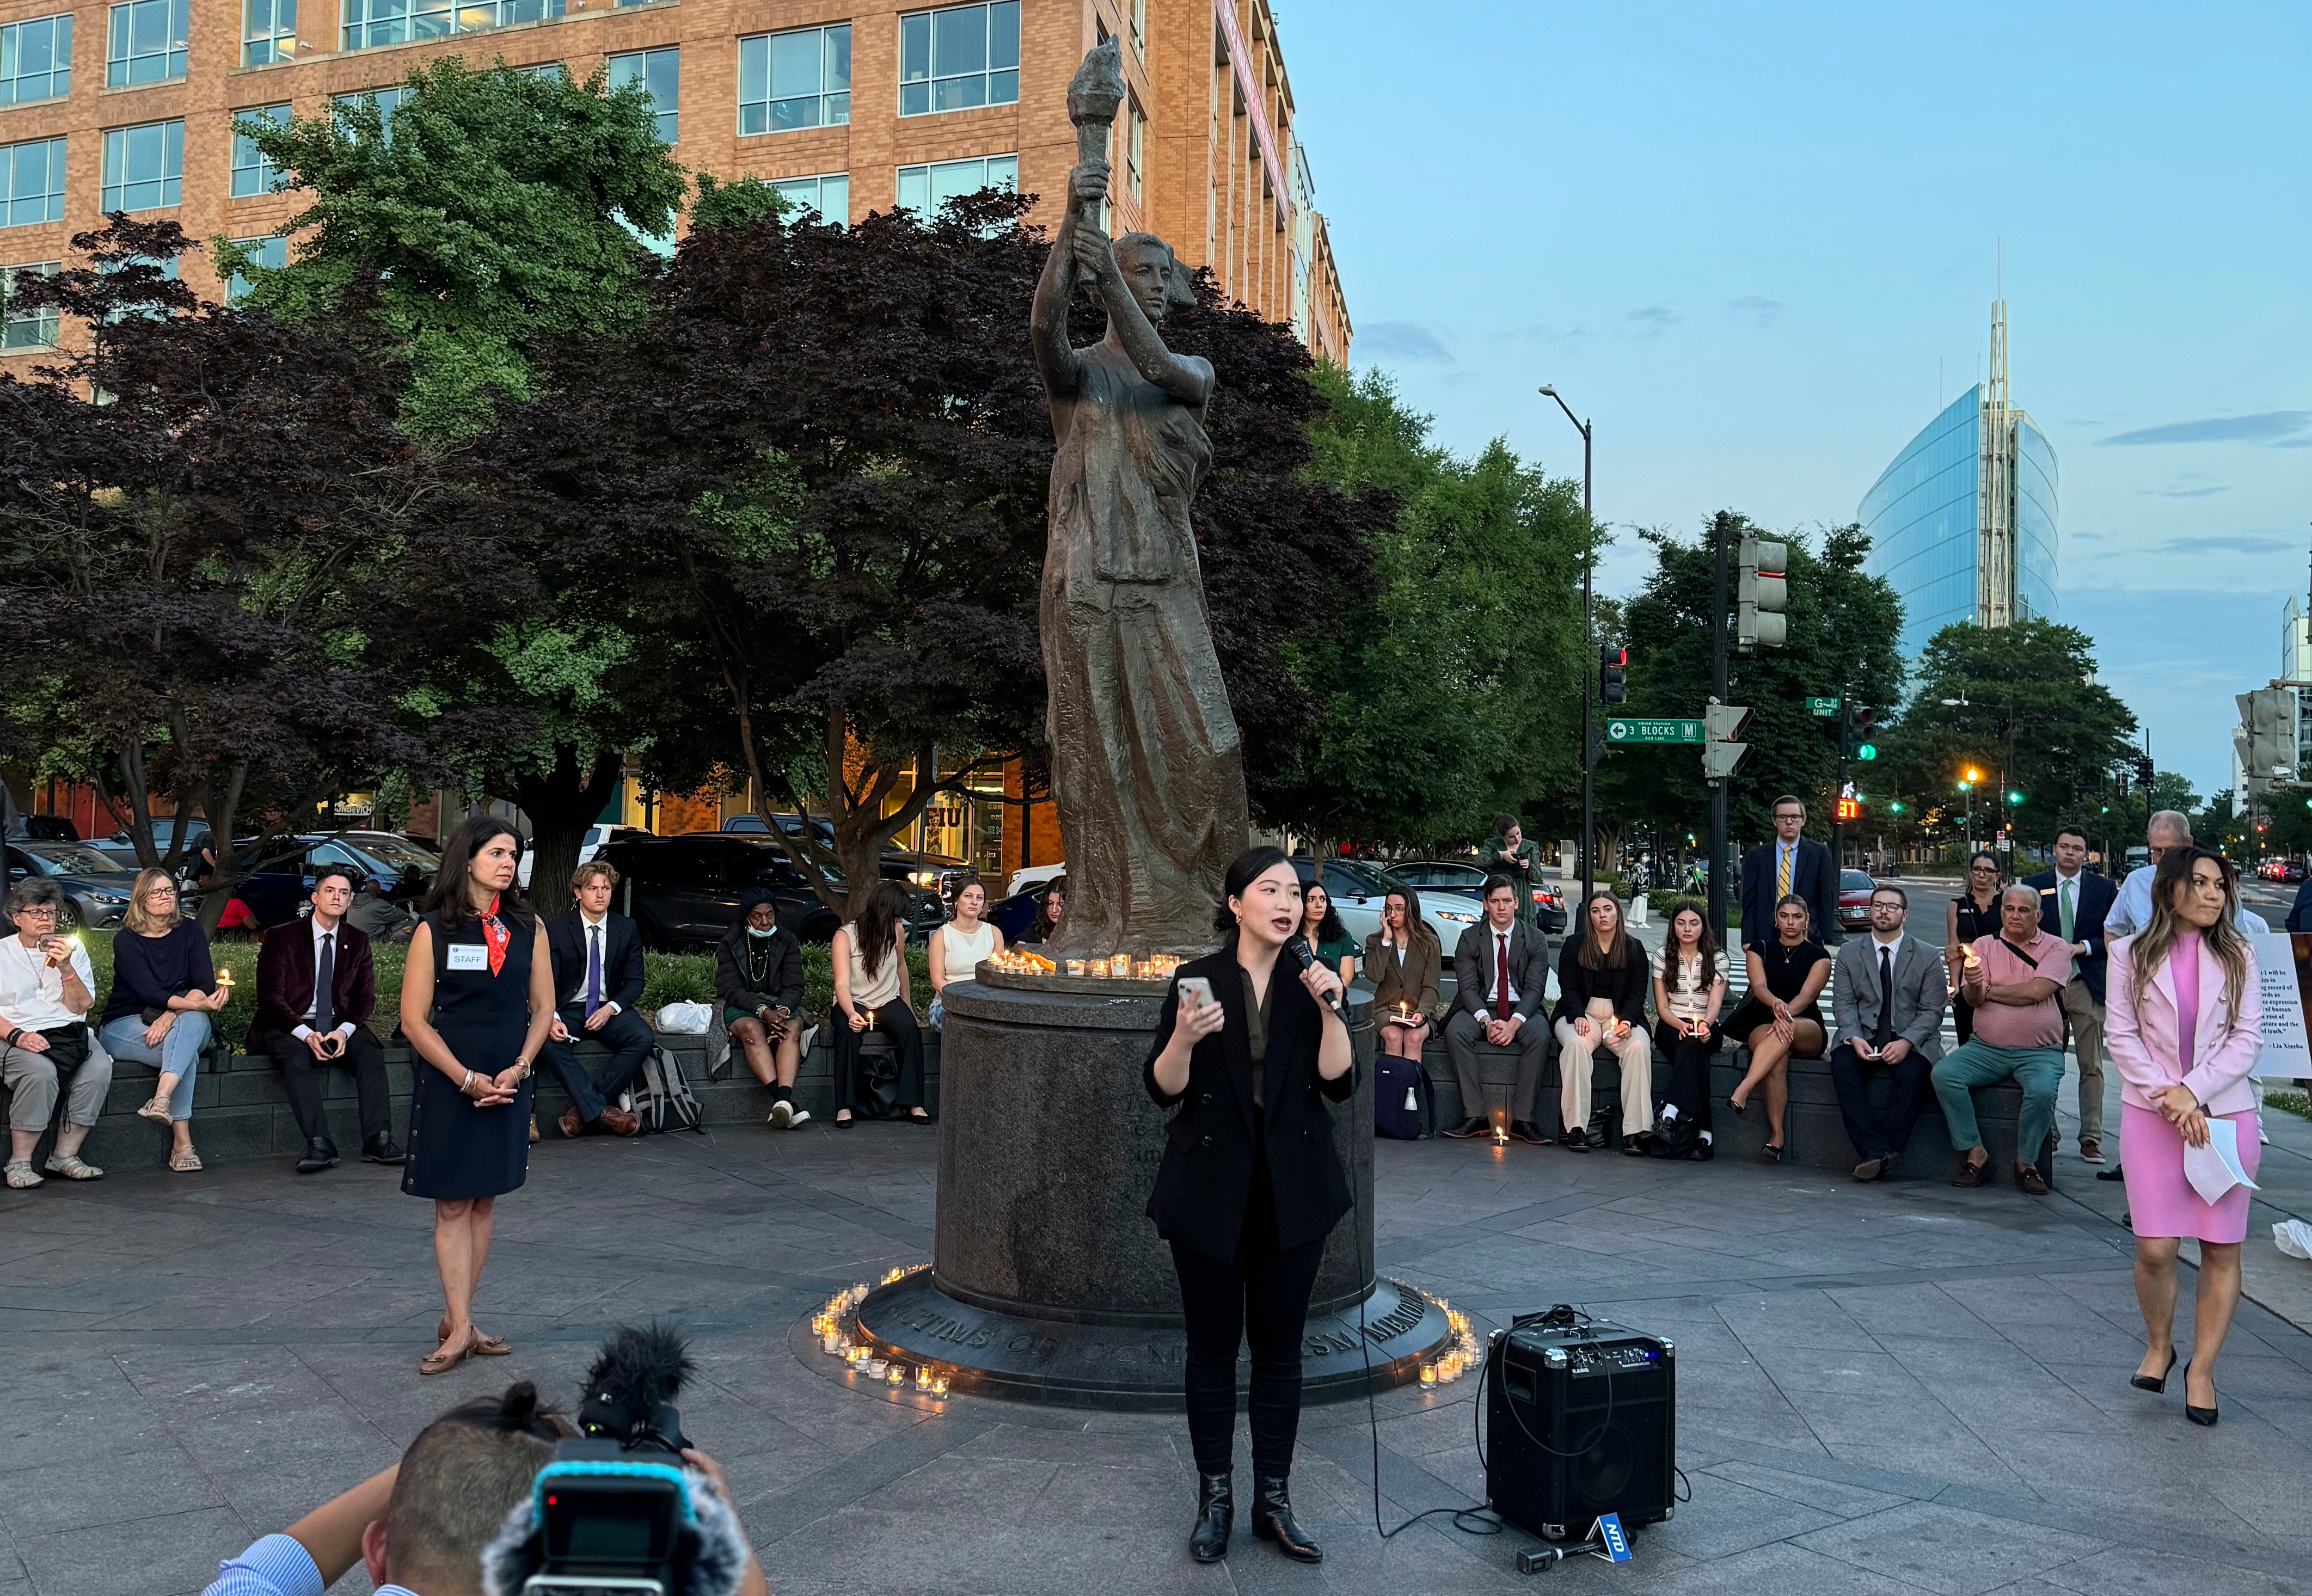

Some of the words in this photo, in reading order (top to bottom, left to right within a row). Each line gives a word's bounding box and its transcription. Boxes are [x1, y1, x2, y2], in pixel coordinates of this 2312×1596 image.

[1814, 698, 1823, 708] G
[1813, 708, 1833, 716] UNIT
[1629, 726, 1634, 735] 3
[1641, 726, 1675, 735] BLOCKS
[1684, 725, 1694, 736] M
[1839, 801, 1855, 818] 37
[1083, 1330, 1362, 1364] COMISM
[1606, 1524, 1624, 1552] NTD
